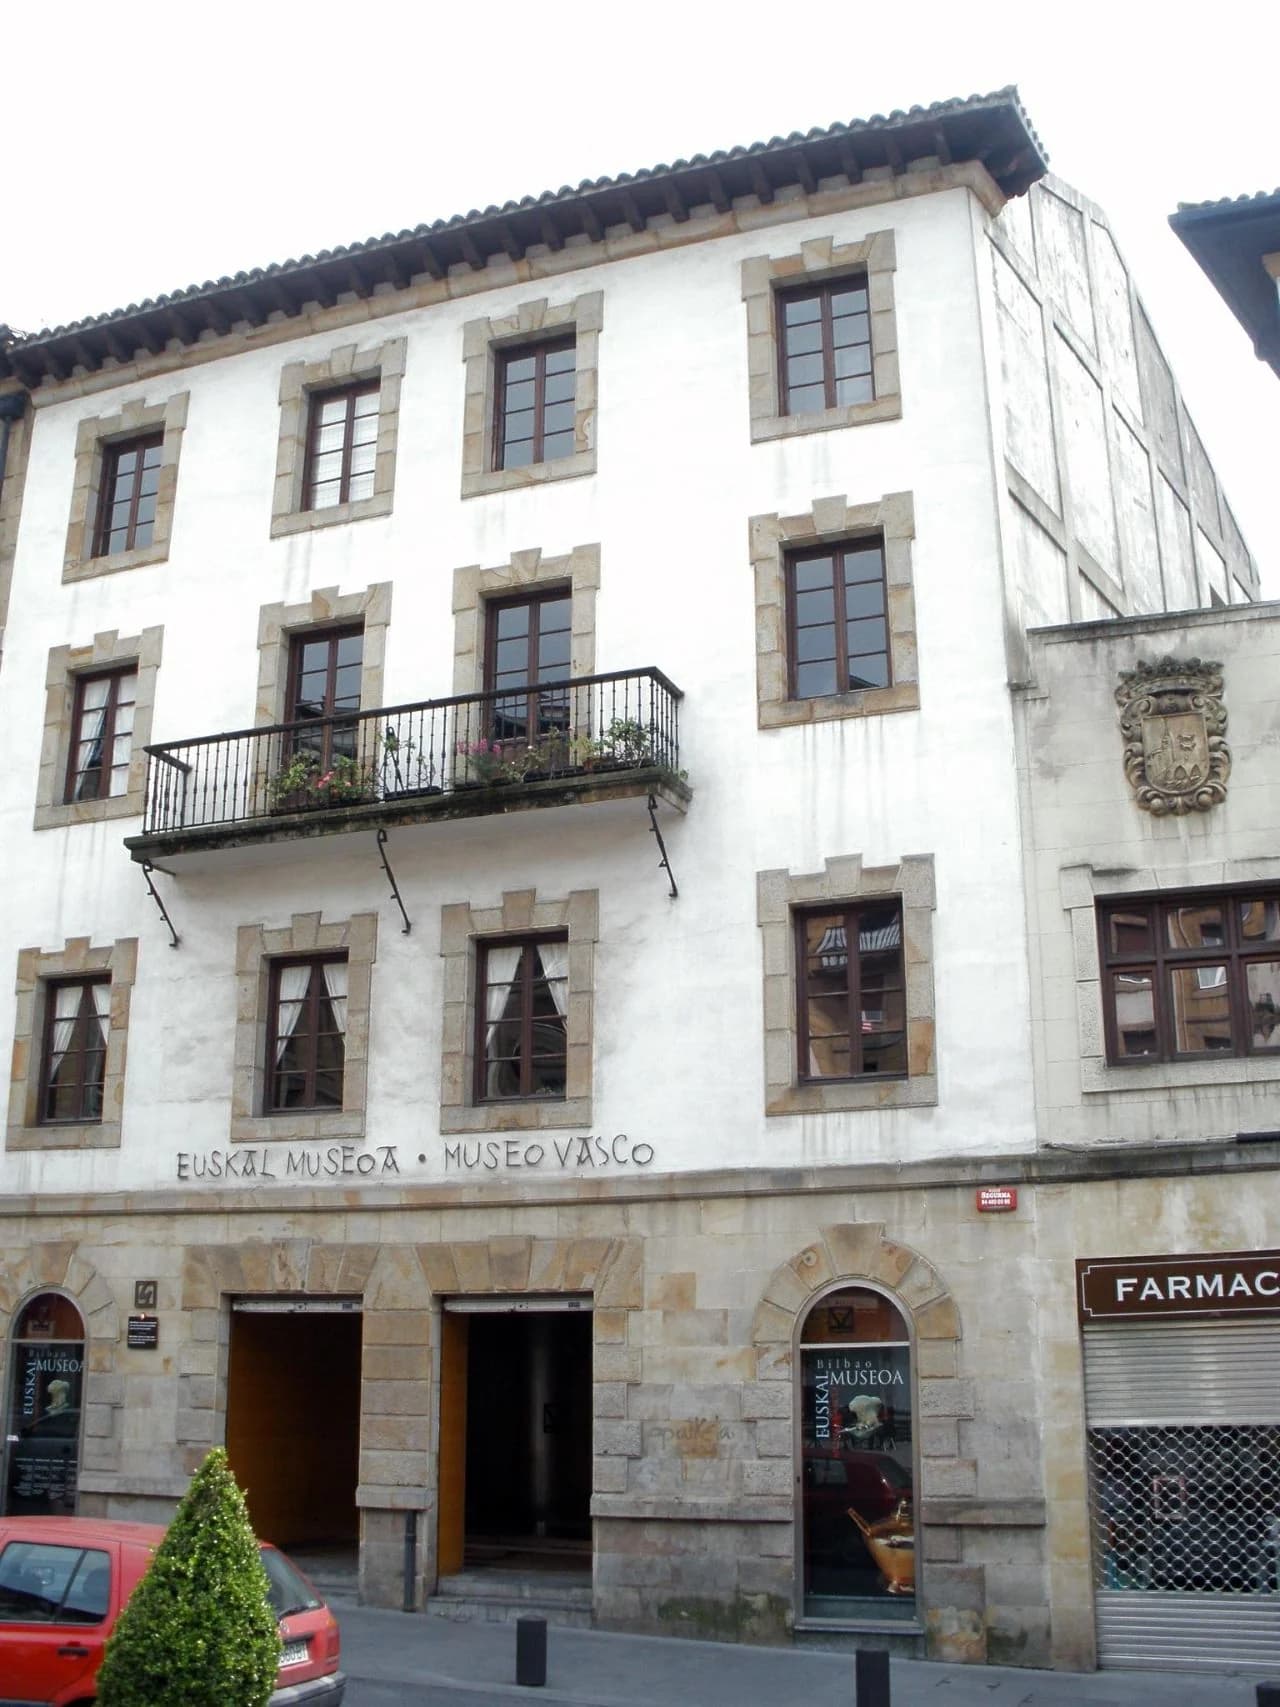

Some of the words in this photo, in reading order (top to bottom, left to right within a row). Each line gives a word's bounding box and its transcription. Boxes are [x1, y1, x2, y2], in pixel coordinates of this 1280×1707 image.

[177, 1150, 276, 1180] EUSKAL
[286, 1145, 401, 1177] MUSEOA
[445, 1138, 545, 1171] MUSEO
[554, 1134, 656, 1168] VASCO
[1115, 1271, 1280, 1302] FARMAC
[817, 1358, 872, 1369] Bilbao
[830, 1369, 904, 1385] MUSEOA
[23, 1361, 37, 1415] EUSKAL
[815, 1370, 829, 1438] EUSKAL
